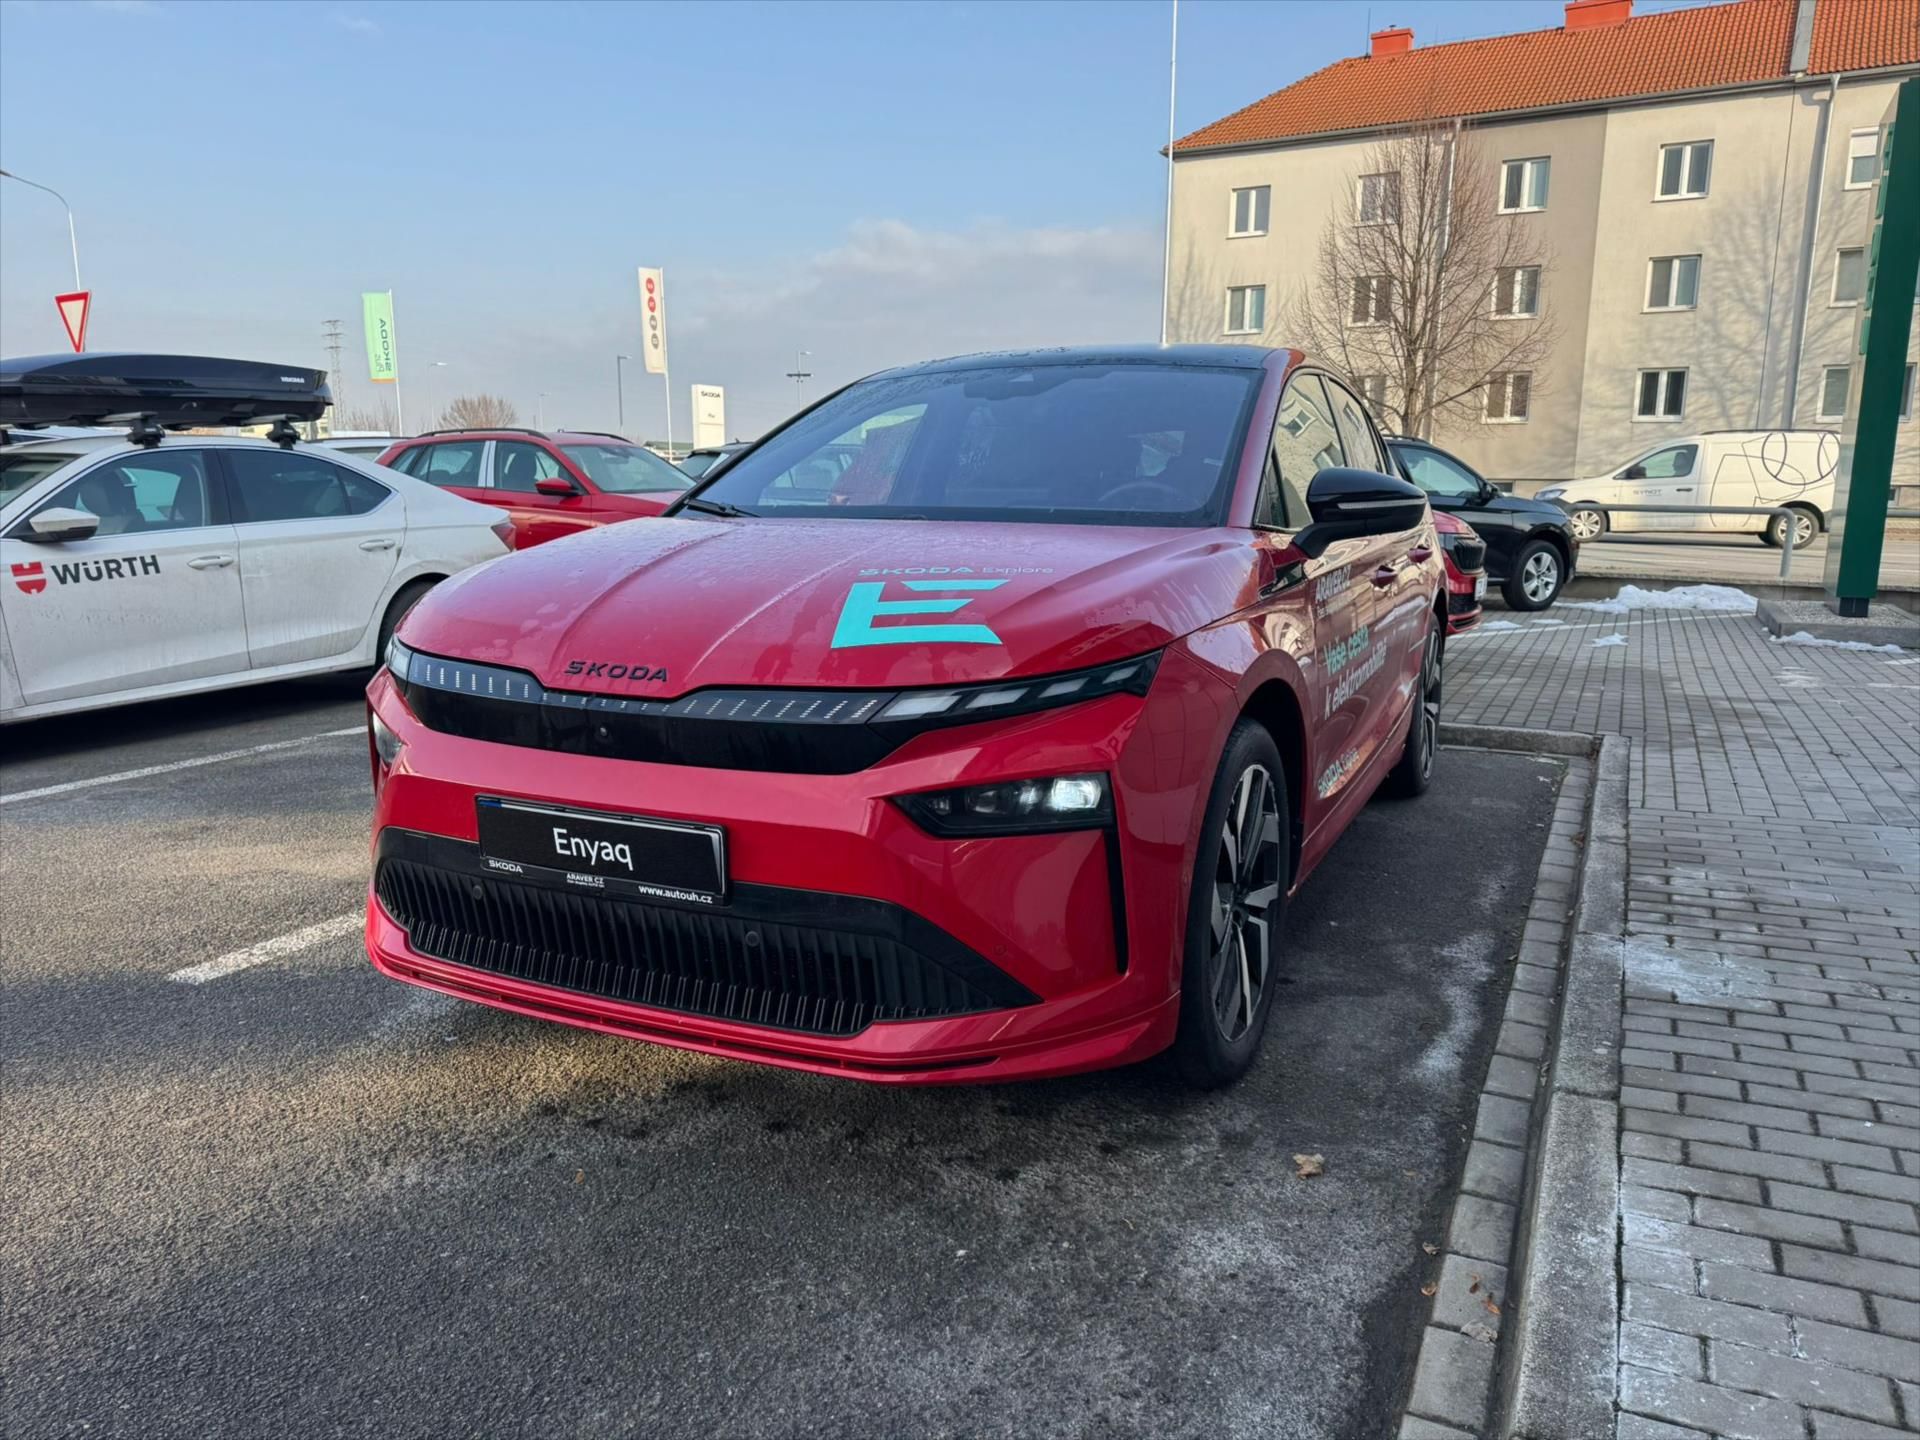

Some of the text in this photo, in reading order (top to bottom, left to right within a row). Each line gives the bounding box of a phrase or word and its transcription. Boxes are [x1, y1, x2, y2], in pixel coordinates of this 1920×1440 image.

[982, 566, 1054, 575] Explore
[1324, 635, 1347, 678] Vaše
[1325, 685, 1332, 721] k
[553, 828, 634, 871] Enyaq
[638, 885, 713, 904] www.autouh.cz
